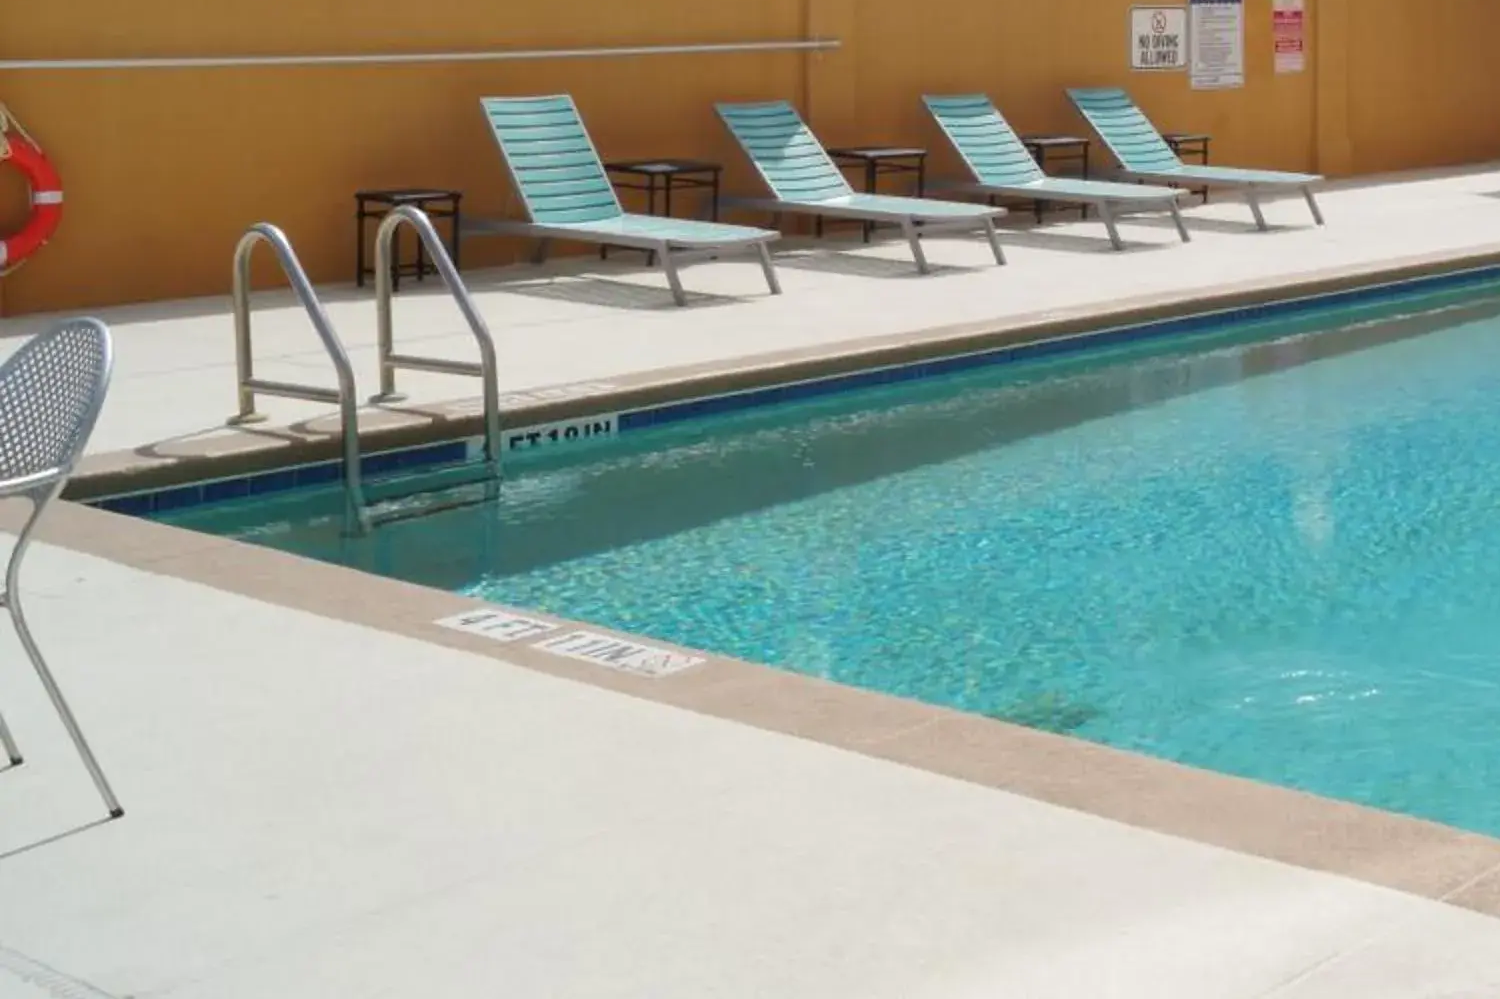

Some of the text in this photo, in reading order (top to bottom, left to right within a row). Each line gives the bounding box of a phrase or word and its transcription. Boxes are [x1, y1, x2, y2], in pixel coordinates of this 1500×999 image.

[1138, 33, 1179, 49] NO DIVING
[1140, 50, 1178, 65] ALLOWED
